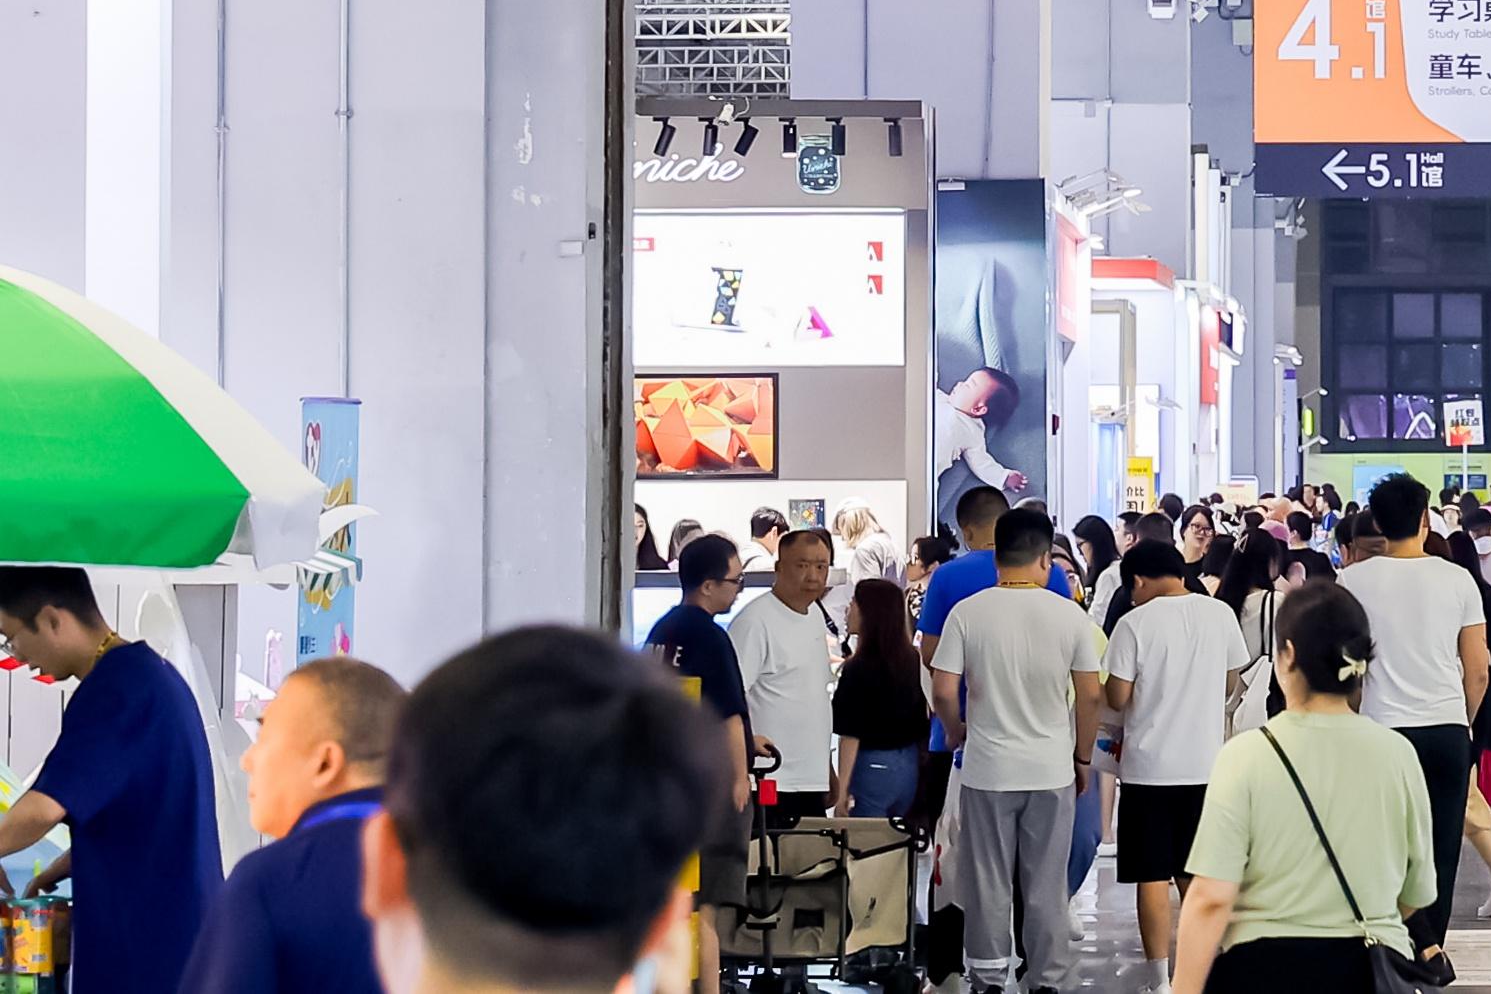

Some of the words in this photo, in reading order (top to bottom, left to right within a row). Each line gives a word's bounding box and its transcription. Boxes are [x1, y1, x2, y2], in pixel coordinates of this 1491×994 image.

[1428, 29, 1459, 41] Study
[1420, 153, 1444, 164] Hall
[1367, 153, 1417, 187] 5.1
[1420, 166, 1443, 187] 馆
